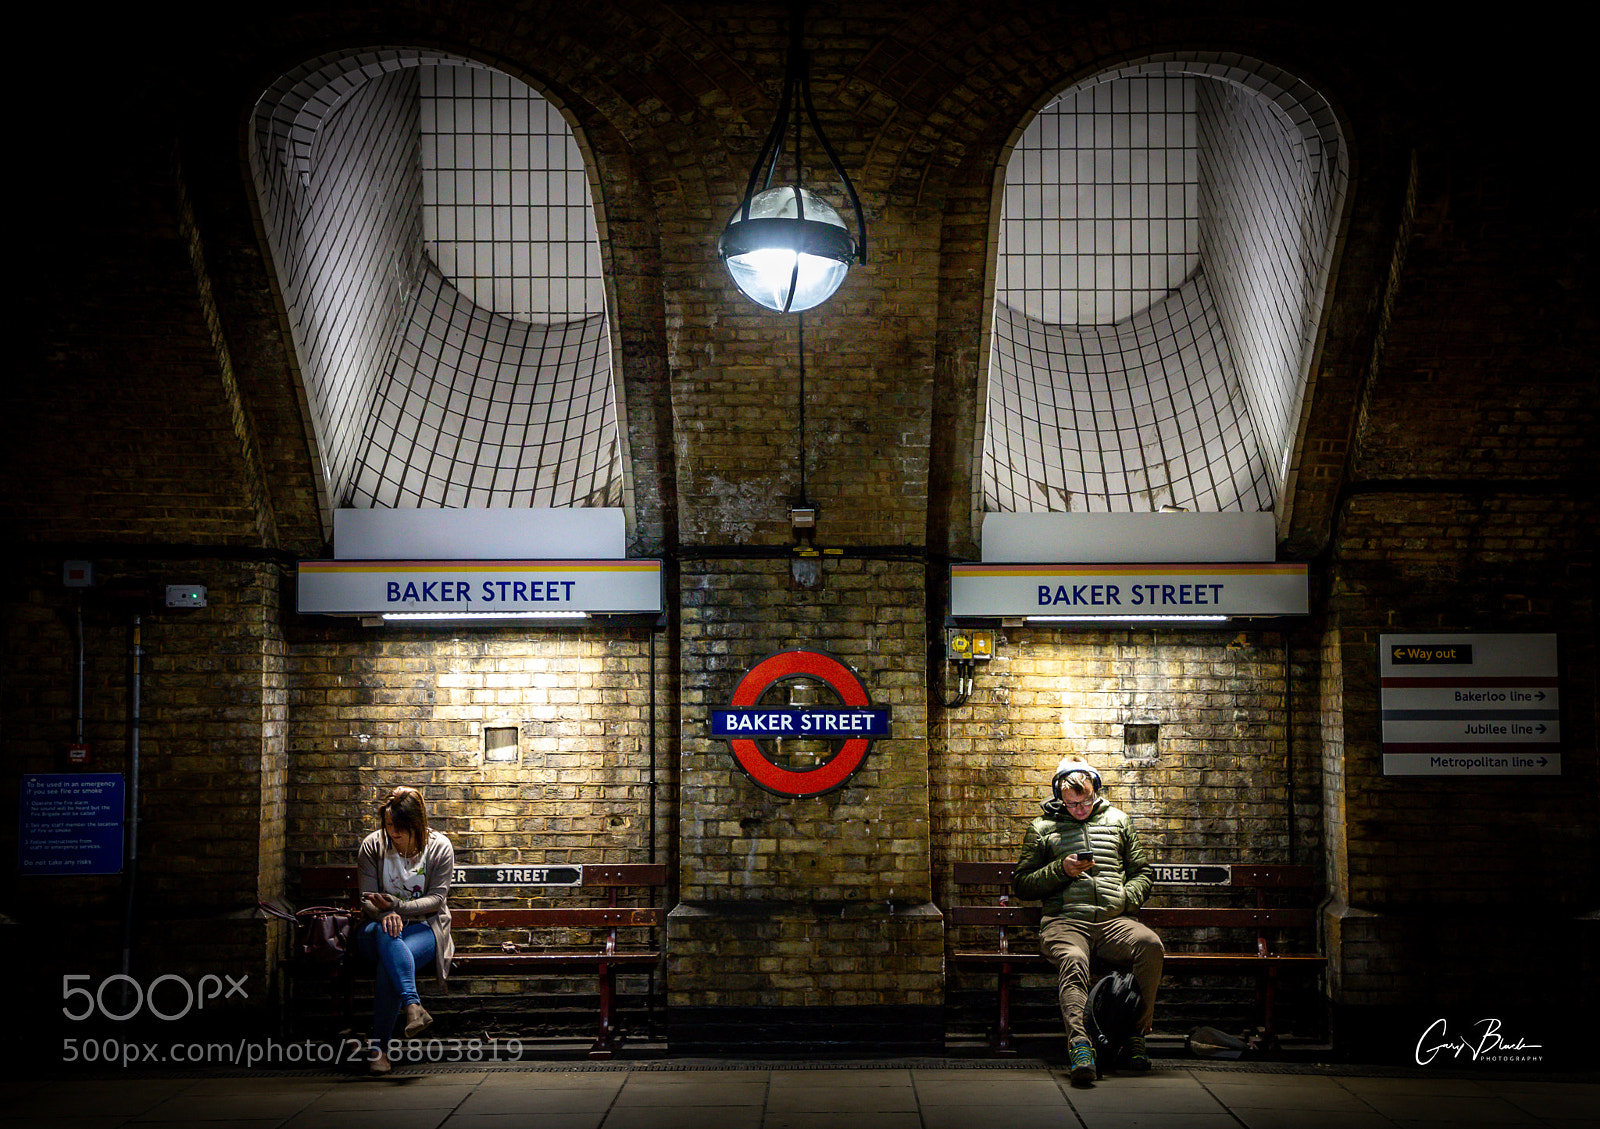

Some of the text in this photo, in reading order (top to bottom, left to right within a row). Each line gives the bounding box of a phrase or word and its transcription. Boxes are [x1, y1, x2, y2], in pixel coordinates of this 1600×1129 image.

[387, 581, 575, 602] BAKER STREET
[1038, 584, 1224, 605] BAKER STREET
[1407, 648, 1457, 661] Way out
[1454, 691, 1532, 702] Bakerloo line
[726, 714, 875, 731] BAKER STREET
[1464, 724, 1533, 735] Jubilee line
[1430, 756, 1534, 770] Metropolitan line
[60, 787, 72, 795] fire
[80, 781, 116, 789] emergency
[496, 869, 549, 882] STREET
[1151, 868, 1198, 880] TREET
